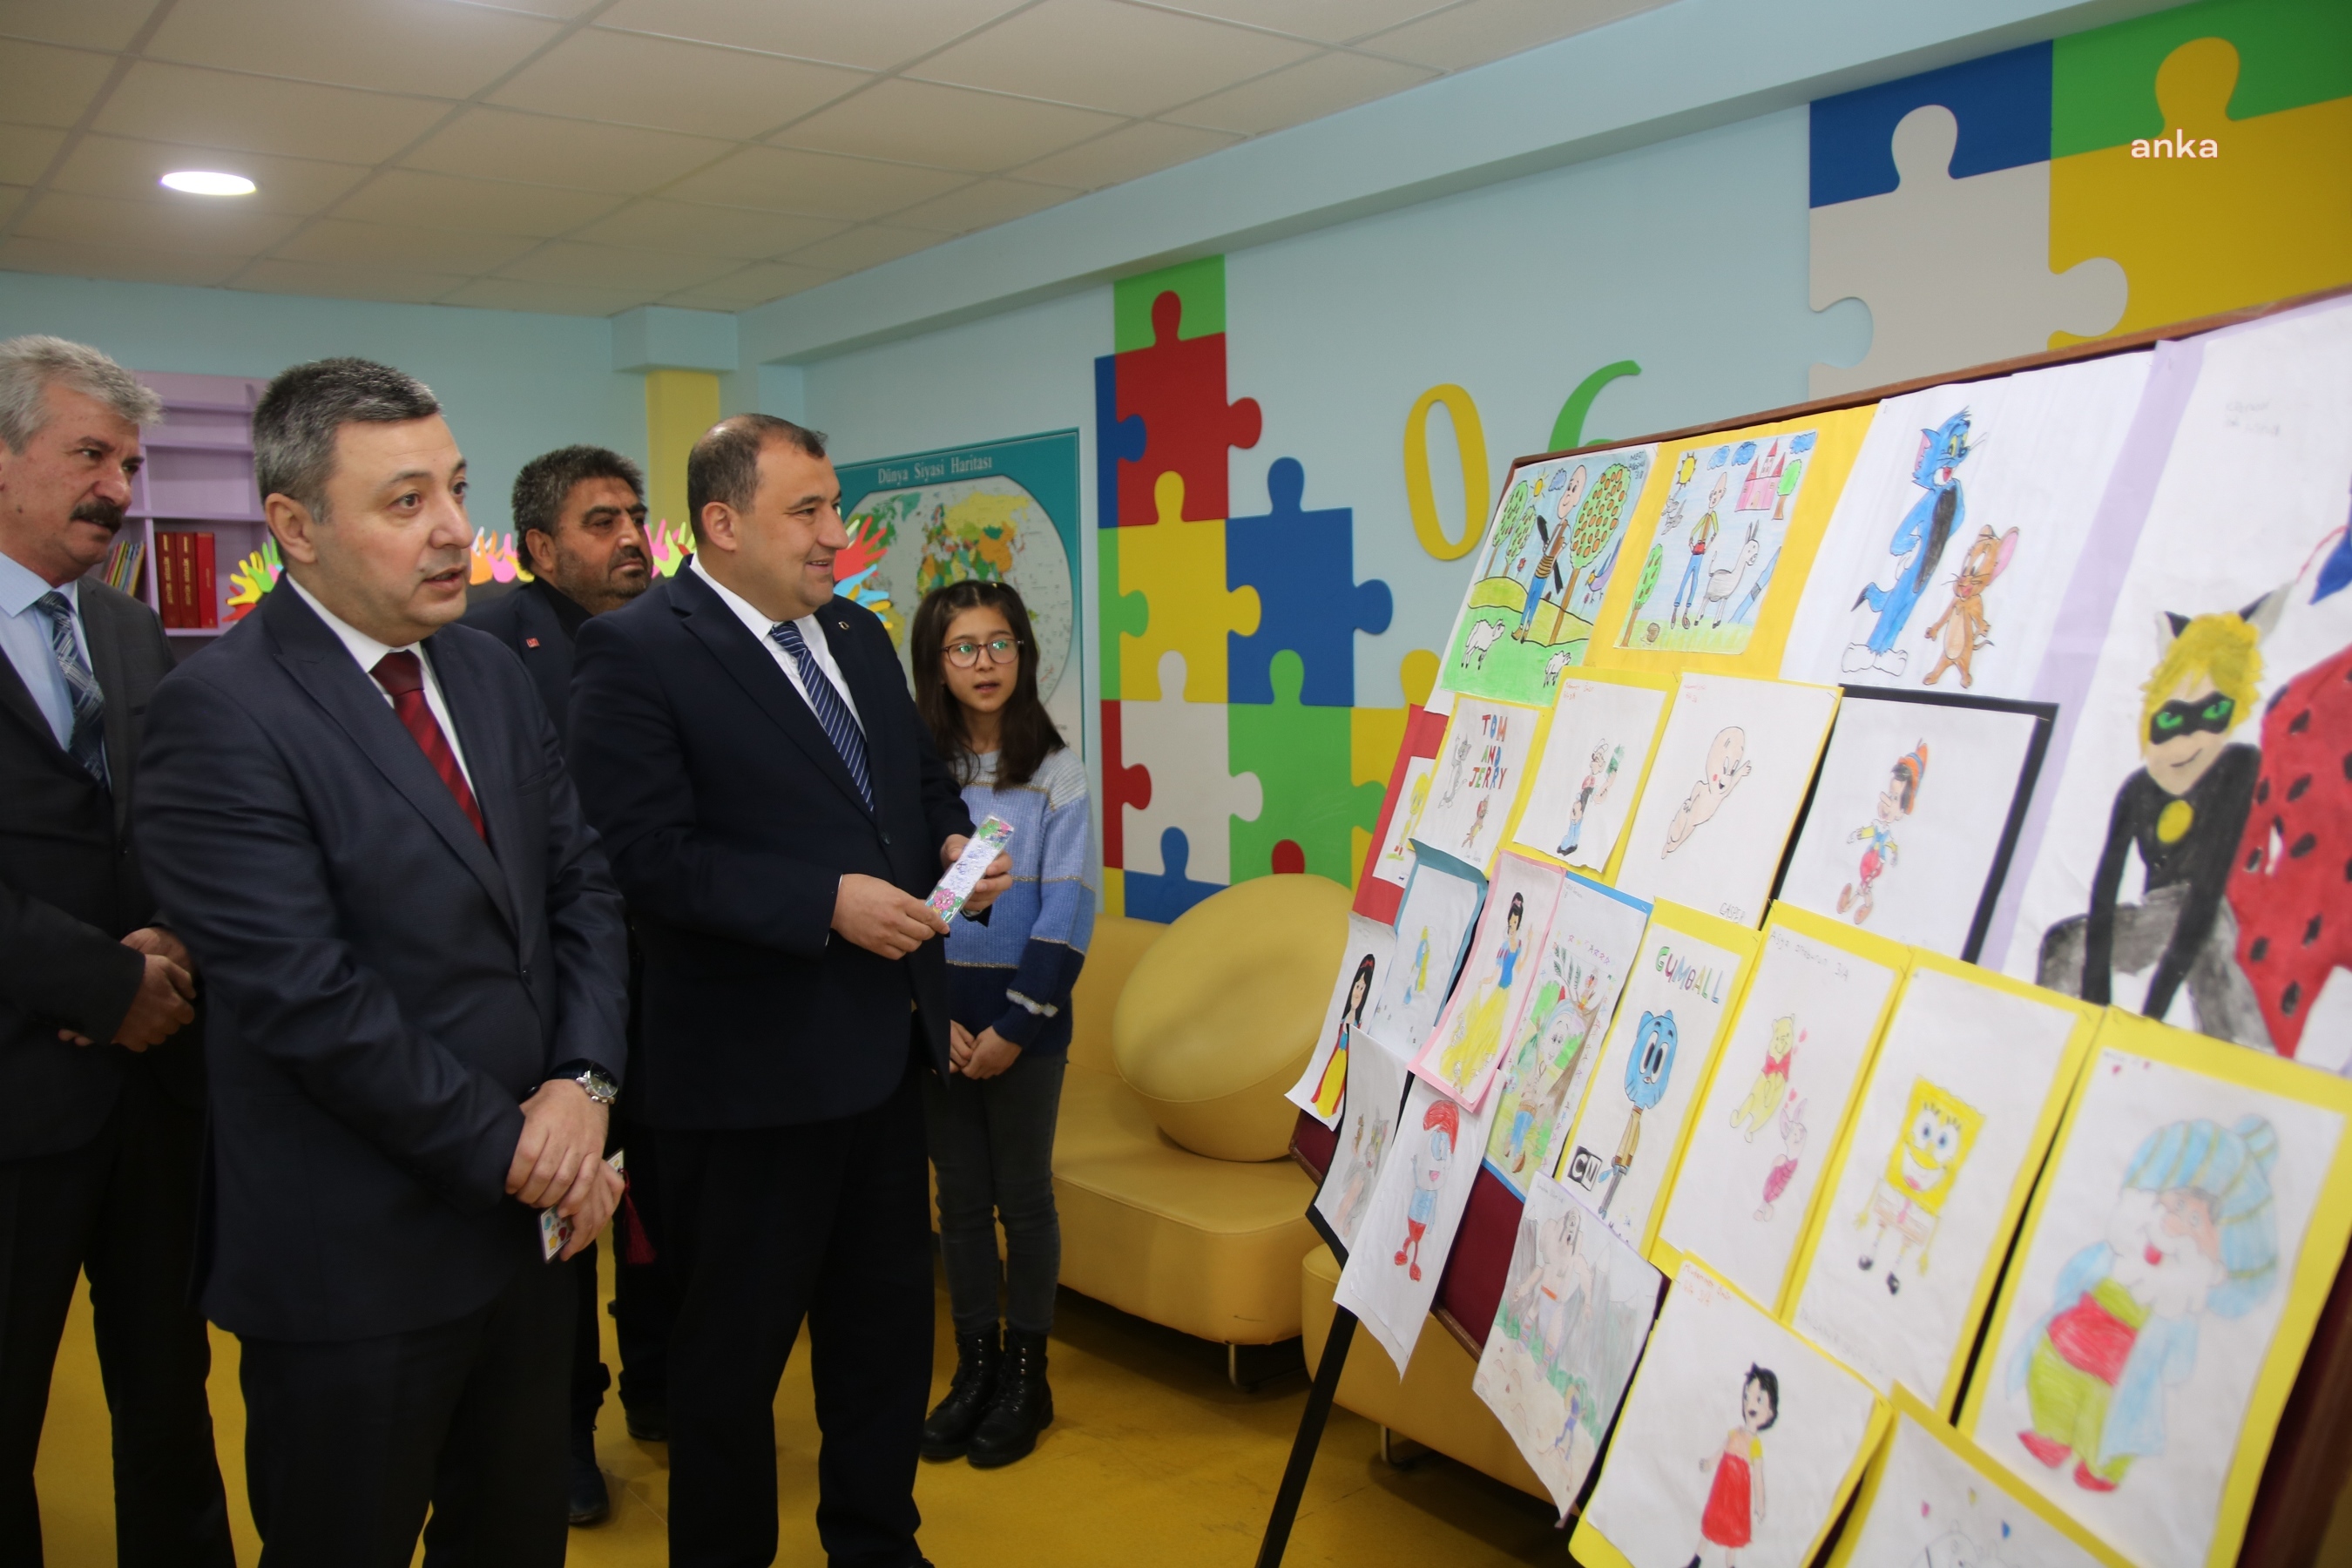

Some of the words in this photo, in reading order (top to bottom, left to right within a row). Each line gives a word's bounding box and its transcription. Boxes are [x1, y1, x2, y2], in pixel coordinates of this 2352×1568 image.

[878, 468, 908, 485] Dünya
[915, 458, 944, 481] Siyasi
[951, 454, 992, 473] Haritası
[1482, 713, 1508, 742] TOM
[1481, 744, 1502, 767] AND
[1468, 766, 1508, 791] JERRY
[1655, 945, 1724, 1004] GUMBALL
